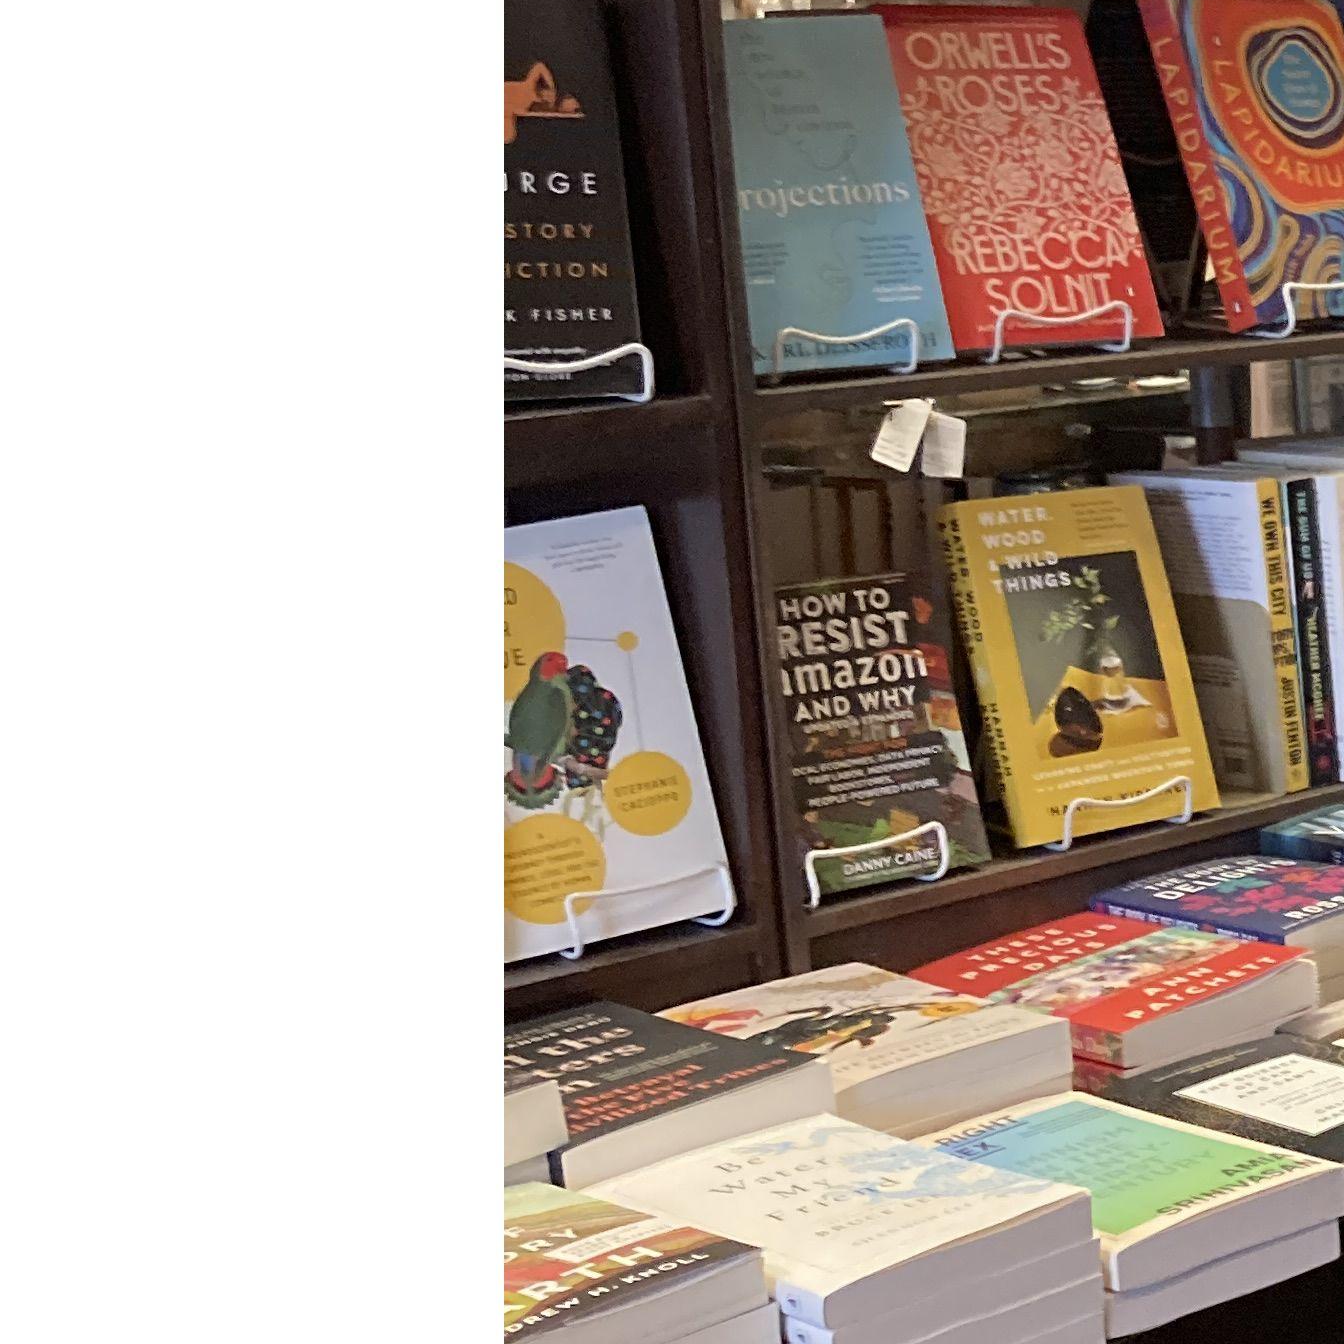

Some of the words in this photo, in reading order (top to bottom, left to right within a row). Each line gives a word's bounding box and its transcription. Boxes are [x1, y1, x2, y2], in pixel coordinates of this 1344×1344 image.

[905, 32, 1071, 70] ORWELL'S
[933, 74, 1062, 112] ROSES
[1153, 37, 1240, 285] LAPIDARIUM
[737, 177, 911, 218] rojections
[952, 230, 1130, 275] REBECCA
[985, 273, 1111, 314] SOLNIT
[531, 307, 614, 323] FISHER
[1260, 497, 1275, 517] WE
[981, 529, 1046, 549] WOOD
[1263, 520, 1279, 551] OWN
[1002, 550, 1059, 570] WILD
[1268, 557, 1282, 584] THIS
[991, 571, 1072, 594] THINGS
[1296, 491, 1308, 513] THE
[1305, 617, 1321, 670] HEATHER
[780, 592, 848, 622] HOW
[853, 587, 891, 612] TO
[1271, 589, 1287, 616] CITY
[775, 610, 911, 660] RESIST
[795, 694, 851, 723] AND
[858, 684, 917, 713] WHY
[1280, 677, 1298, 718] JUSTIN
[990, 702, 1012, 777] HANNAH
[613, 775, 680, 799] STEPHANIE
[843, 855, 892, 876] DANNY
[894, 847, 939, 866] CAINE
[1153, 858, 1298, 900] DELIGHTS
[1144, 875, 1181, 892] THE
[958, 922, 1118, 981] PRECIOUS
[966, 926, 1065, 962] THESE
[1022, 940, 1107, 973] DAYS
[1123, 955, 1278, 1020] PATCHETT
[1142, 966, 1214, 997] ANN
[537, 1026, 635, 1057] the
[531, 1043, 647, 1079] ters
[934, 1114, 1020, 1148] RIGHT
[709, 1156, 831, 1196] Water
[713, 1156, 763, 1174] Be
[1221, 1150, 1285, 1179] AMIA
[765, 1175, 903, 1223] Friend
[770, 1178, 832, 1199] My
[1156, 1157, 1322, 1217] SRINIVASAN
[620, 1253, 710, 1284] KNOLL
